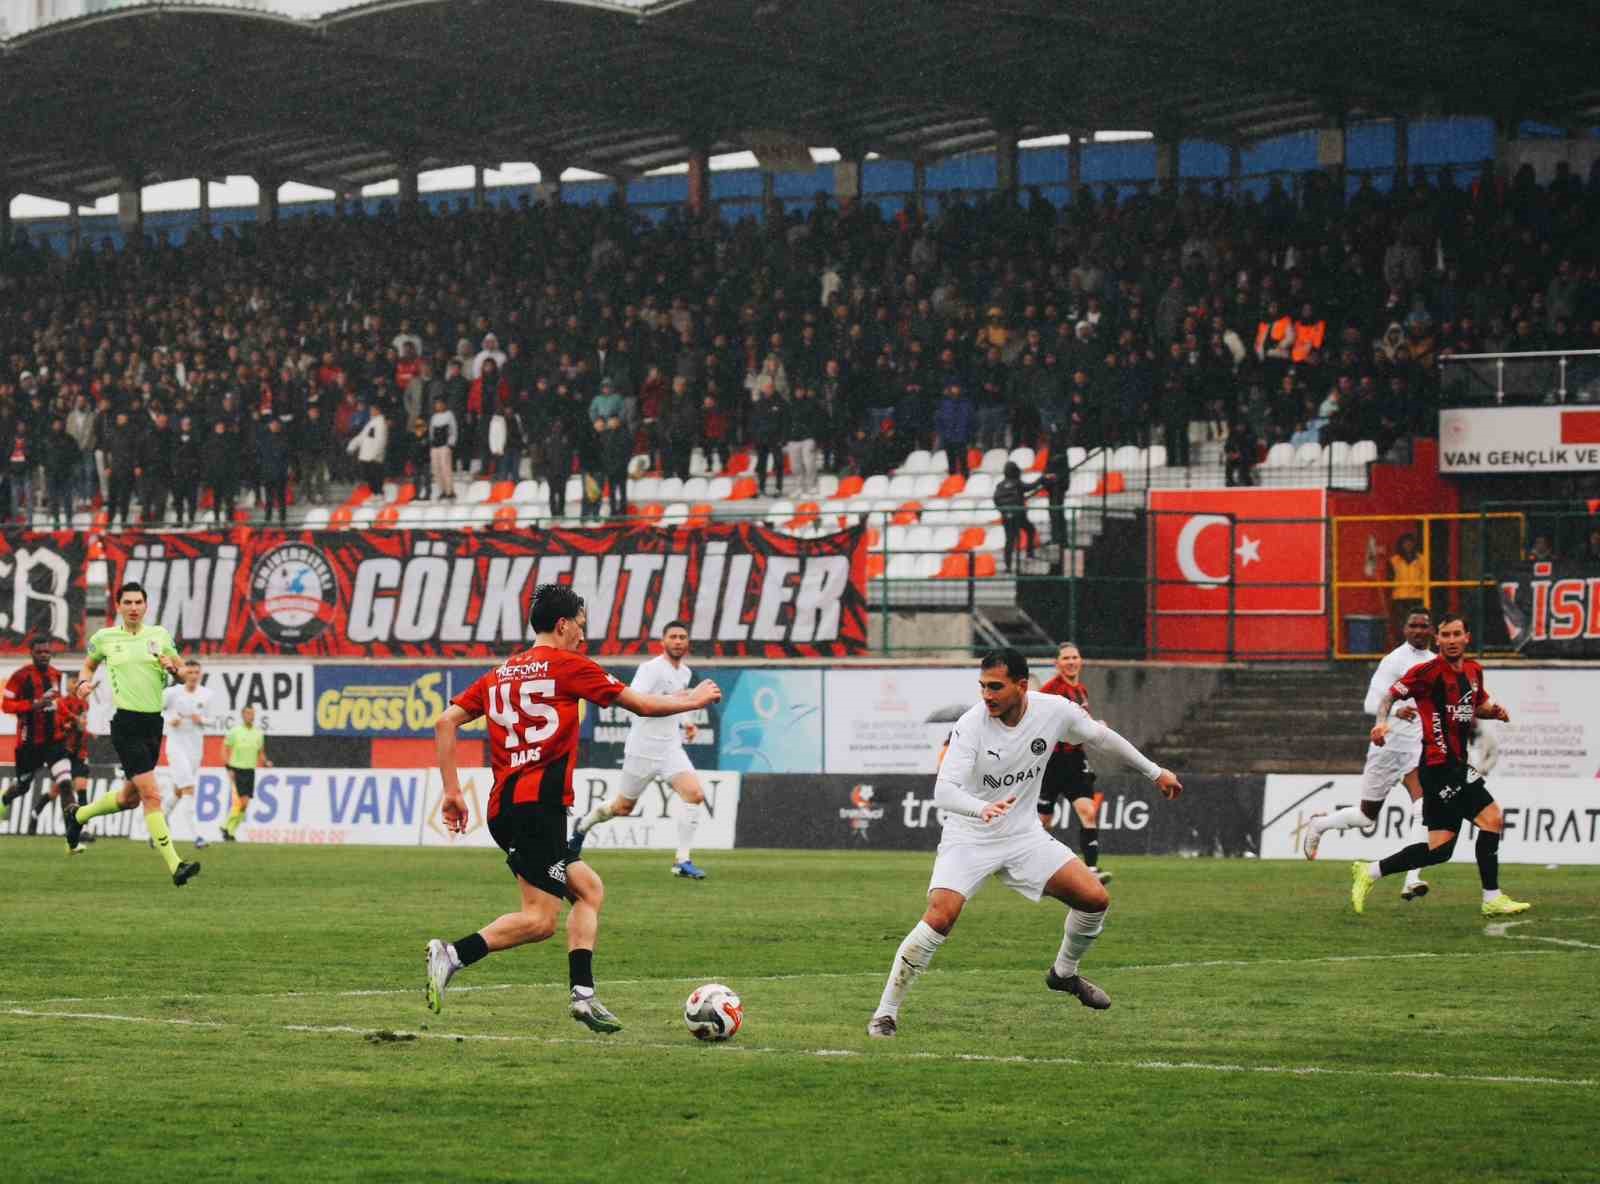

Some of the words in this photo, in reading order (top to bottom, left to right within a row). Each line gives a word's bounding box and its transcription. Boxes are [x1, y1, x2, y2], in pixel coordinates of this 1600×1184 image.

[1444, 451, 1481, 466] VAN
[1487, 448, 1568, 467] GENÇLİK
[1575, 449, 1598, 463] VE
[222, 672, 303, 711] YAPI
[488, 679, 560, 749] 45
[328, 776, 417, 824] VAN
[1099, 795, 1150, 830] LİG
[1499, 807, 1600, 842] FIRAT
